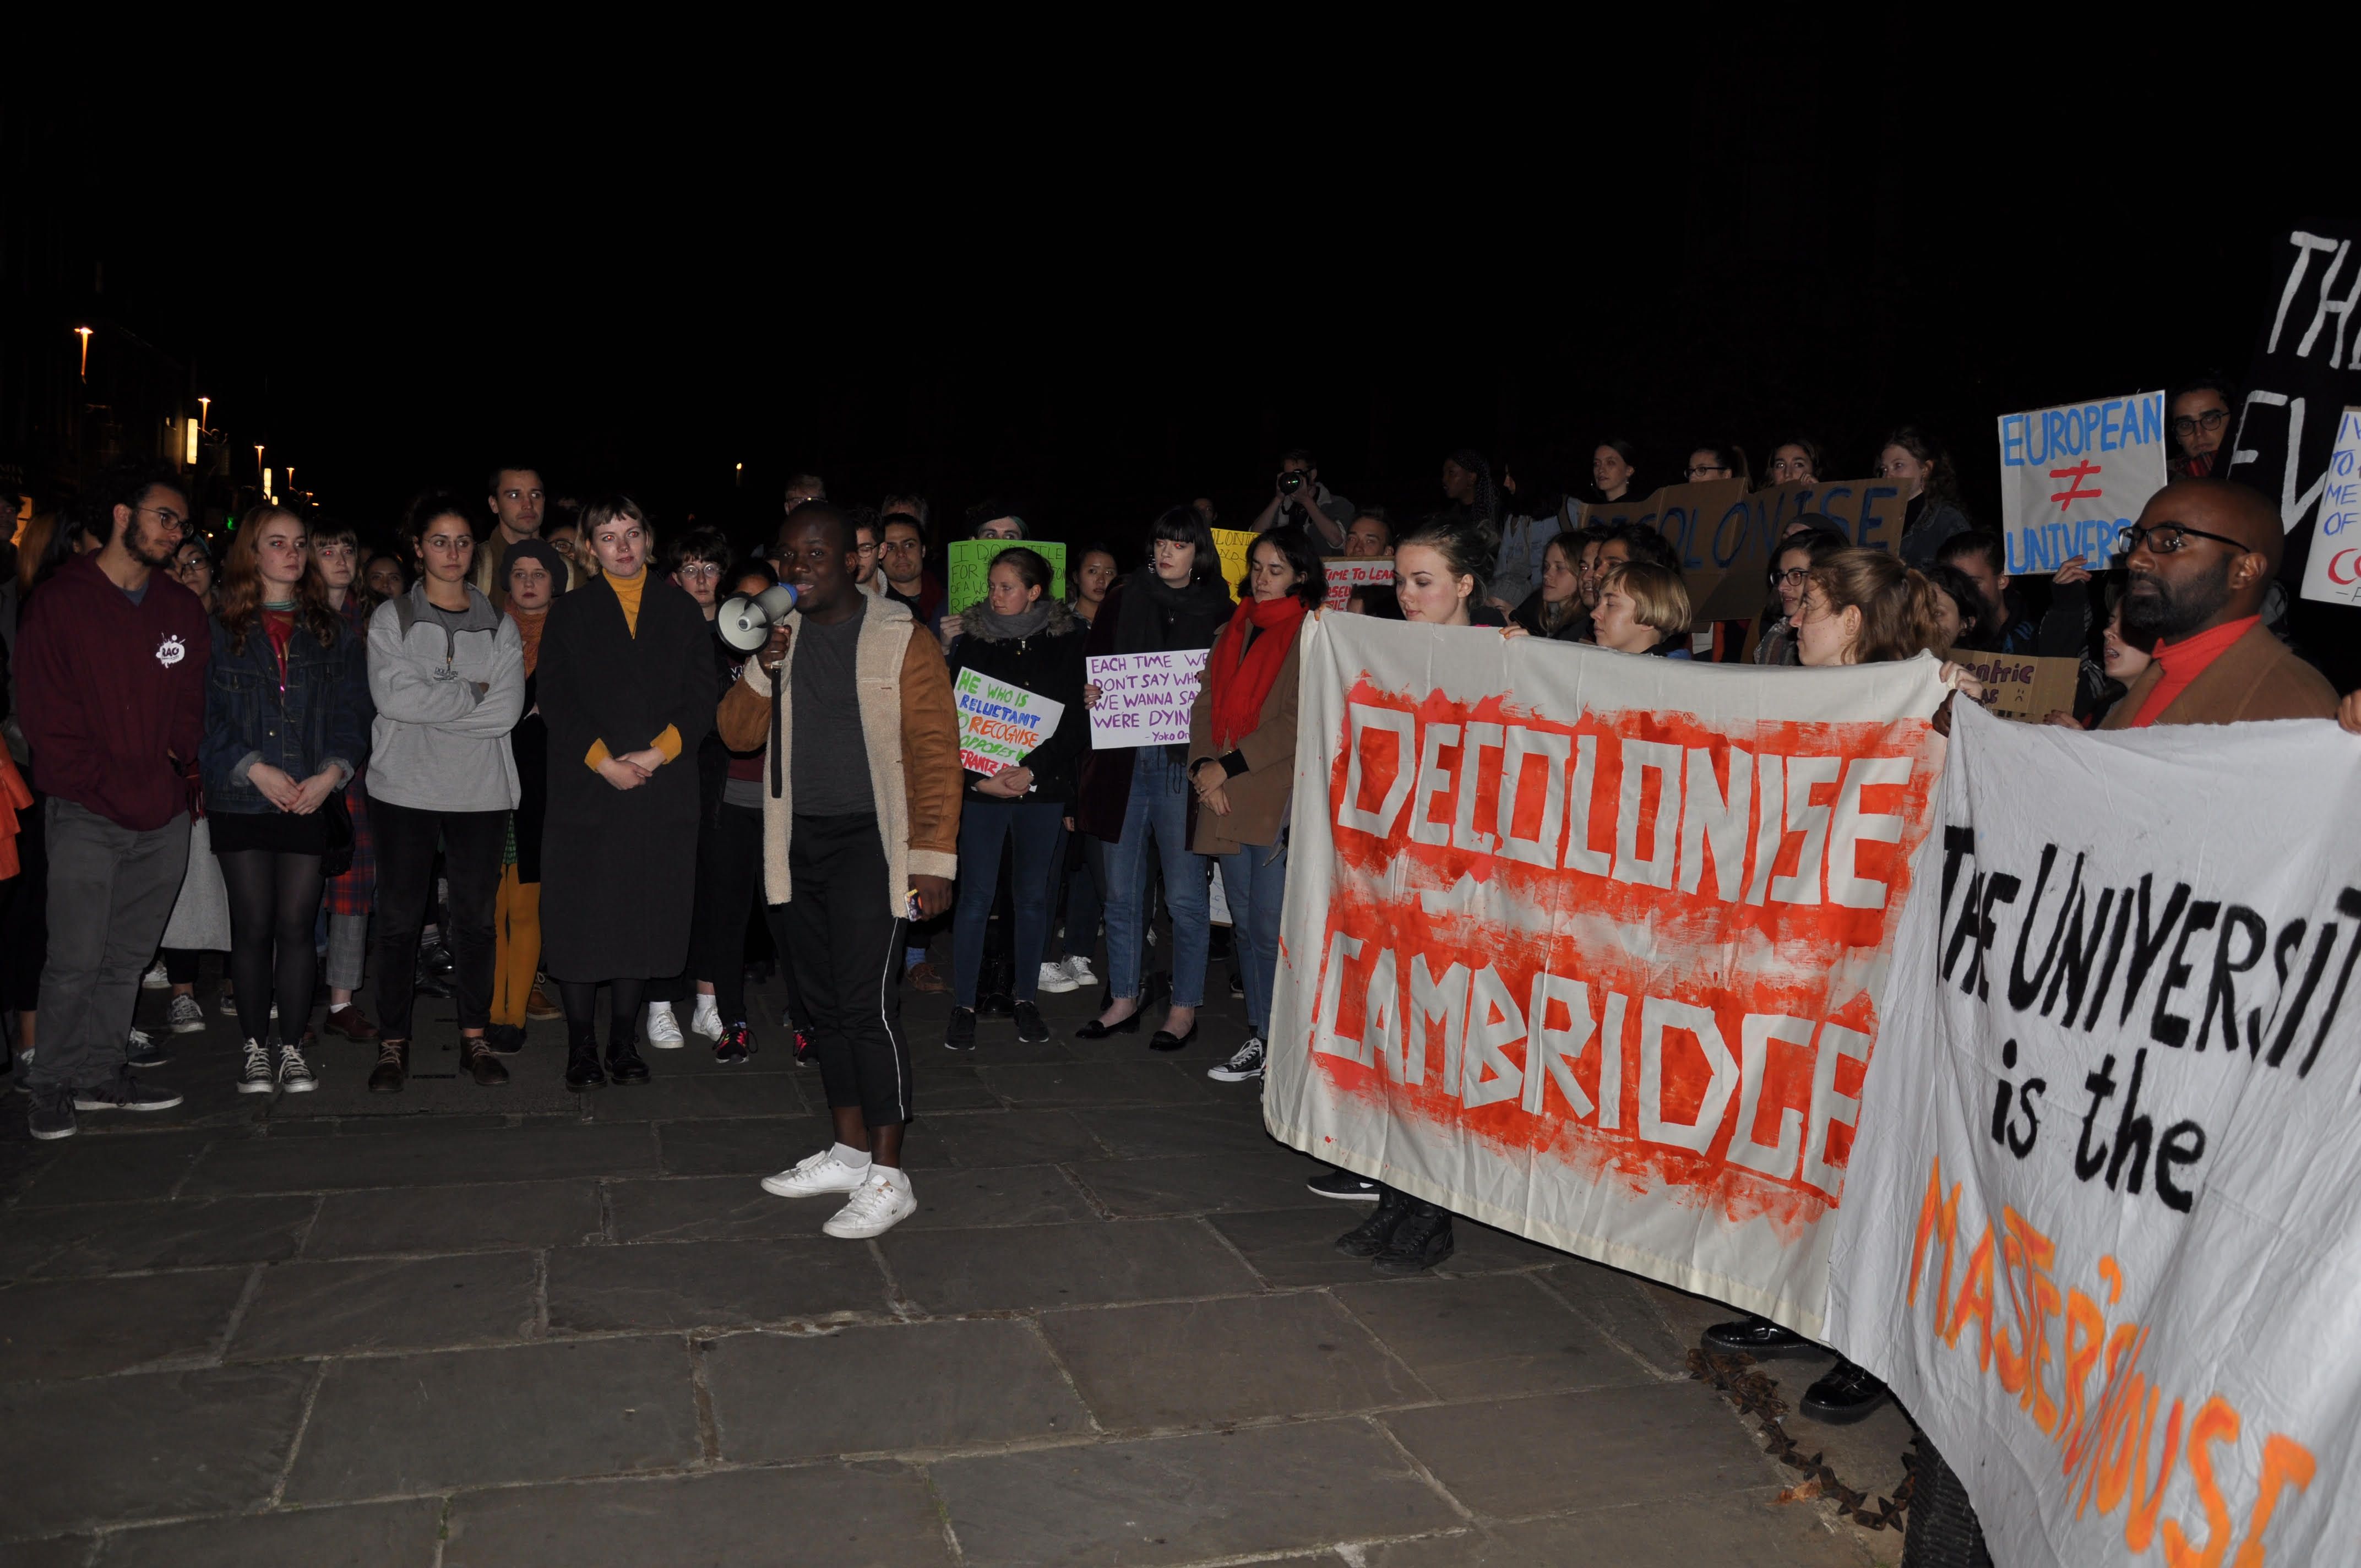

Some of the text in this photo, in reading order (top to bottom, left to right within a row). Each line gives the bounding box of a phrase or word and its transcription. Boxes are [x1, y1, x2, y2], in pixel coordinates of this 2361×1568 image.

[2267, 231, 2361, 370] TH
[2003, 395, 2163, 466] EUROPEAN
[2324, 512, 2359, 536] OF
[952, 564, 978, 582] FOR
[1323, 568, 1349, 581] TIME
[1352, 568, 1366, 580] TO
[1091, 657, 1127, 674] EACH
[1133, 655, 1172, 669] TIME
[958, 670, 1029, 707] HE WHO IS
[1093, 674, 1138, 692] DON'T
[1141, 673, 1169, 688] SAY
[960, 694, 1041, 729] RELUCTANT
[1094, 690, 1199, 711] WE WANNA SA
[969, 716, 1039, 748] RECOGNISE
[1093, 708, 1190, 728] WE'RE DYIN
[1152, 730, 1189, 742] Yoko On
[1338, 702, 1913, 909] DECOLONISE
[1936, 825, 2361, 1079] THE UNIVERSIT
[1314, 929, 1873, 1199] CAMBRIDGE
[1992, 1038, 2206, 1213] is the
